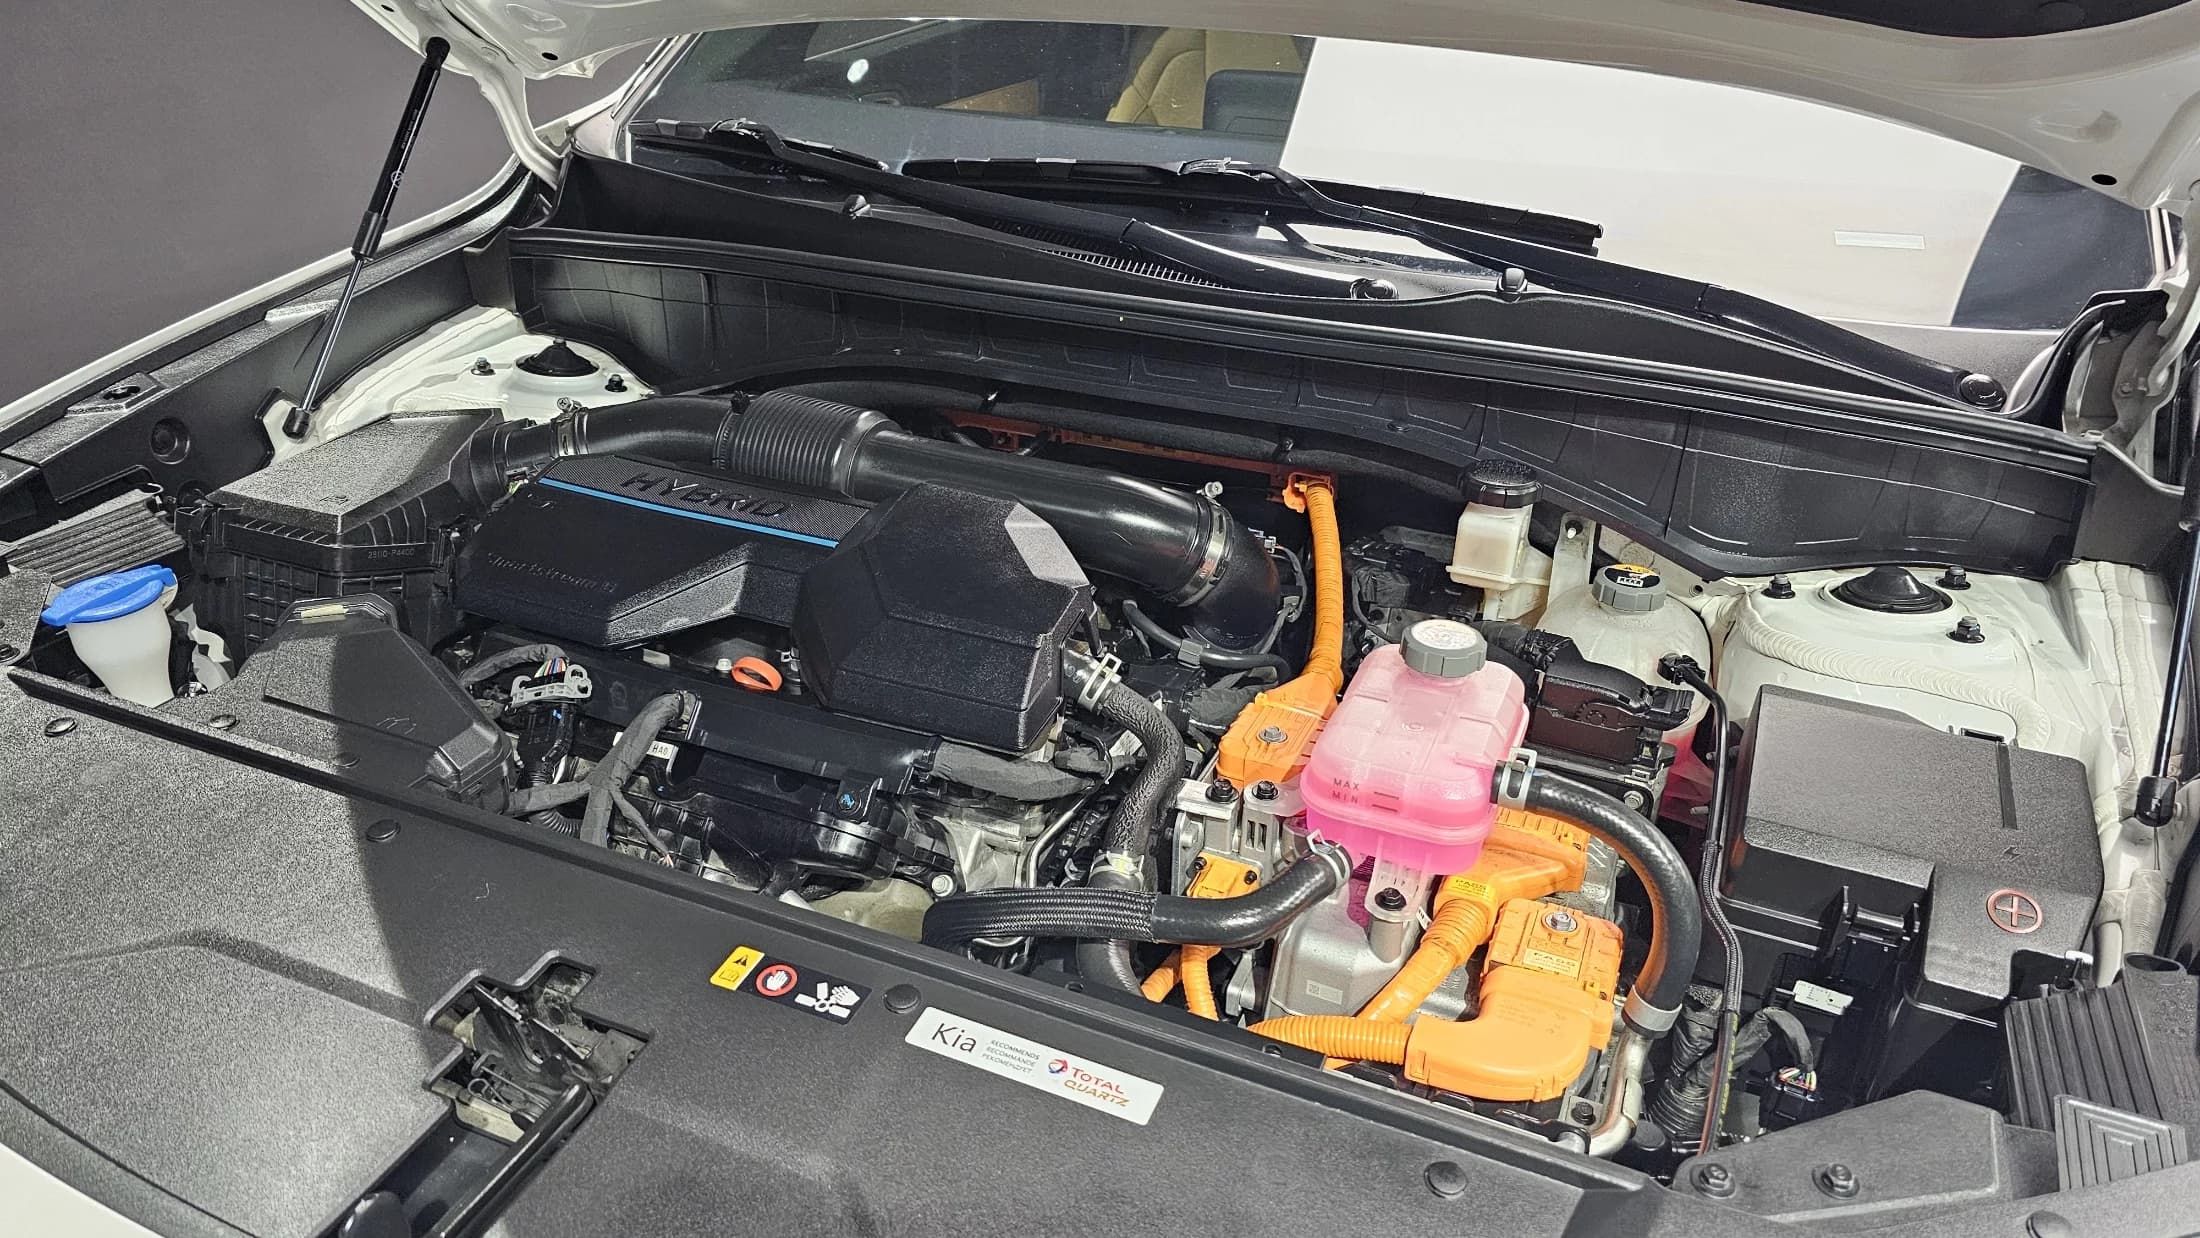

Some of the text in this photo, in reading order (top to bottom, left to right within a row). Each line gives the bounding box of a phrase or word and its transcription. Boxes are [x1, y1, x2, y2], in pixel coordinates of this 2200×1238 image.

[620, 472, 793, 518] HYBRID
[1332, 791, 1359, 804] MIN
[1334, 778, 1360, 791] MAX
[931, 1022, 977, 1053] Kia
[990, 1039, 1040, 1060] RECOMMENDS
[1063, 1079, 1131, 1107] QUARTZ
[1071, 1066, 1124, 1095] TOTAL
